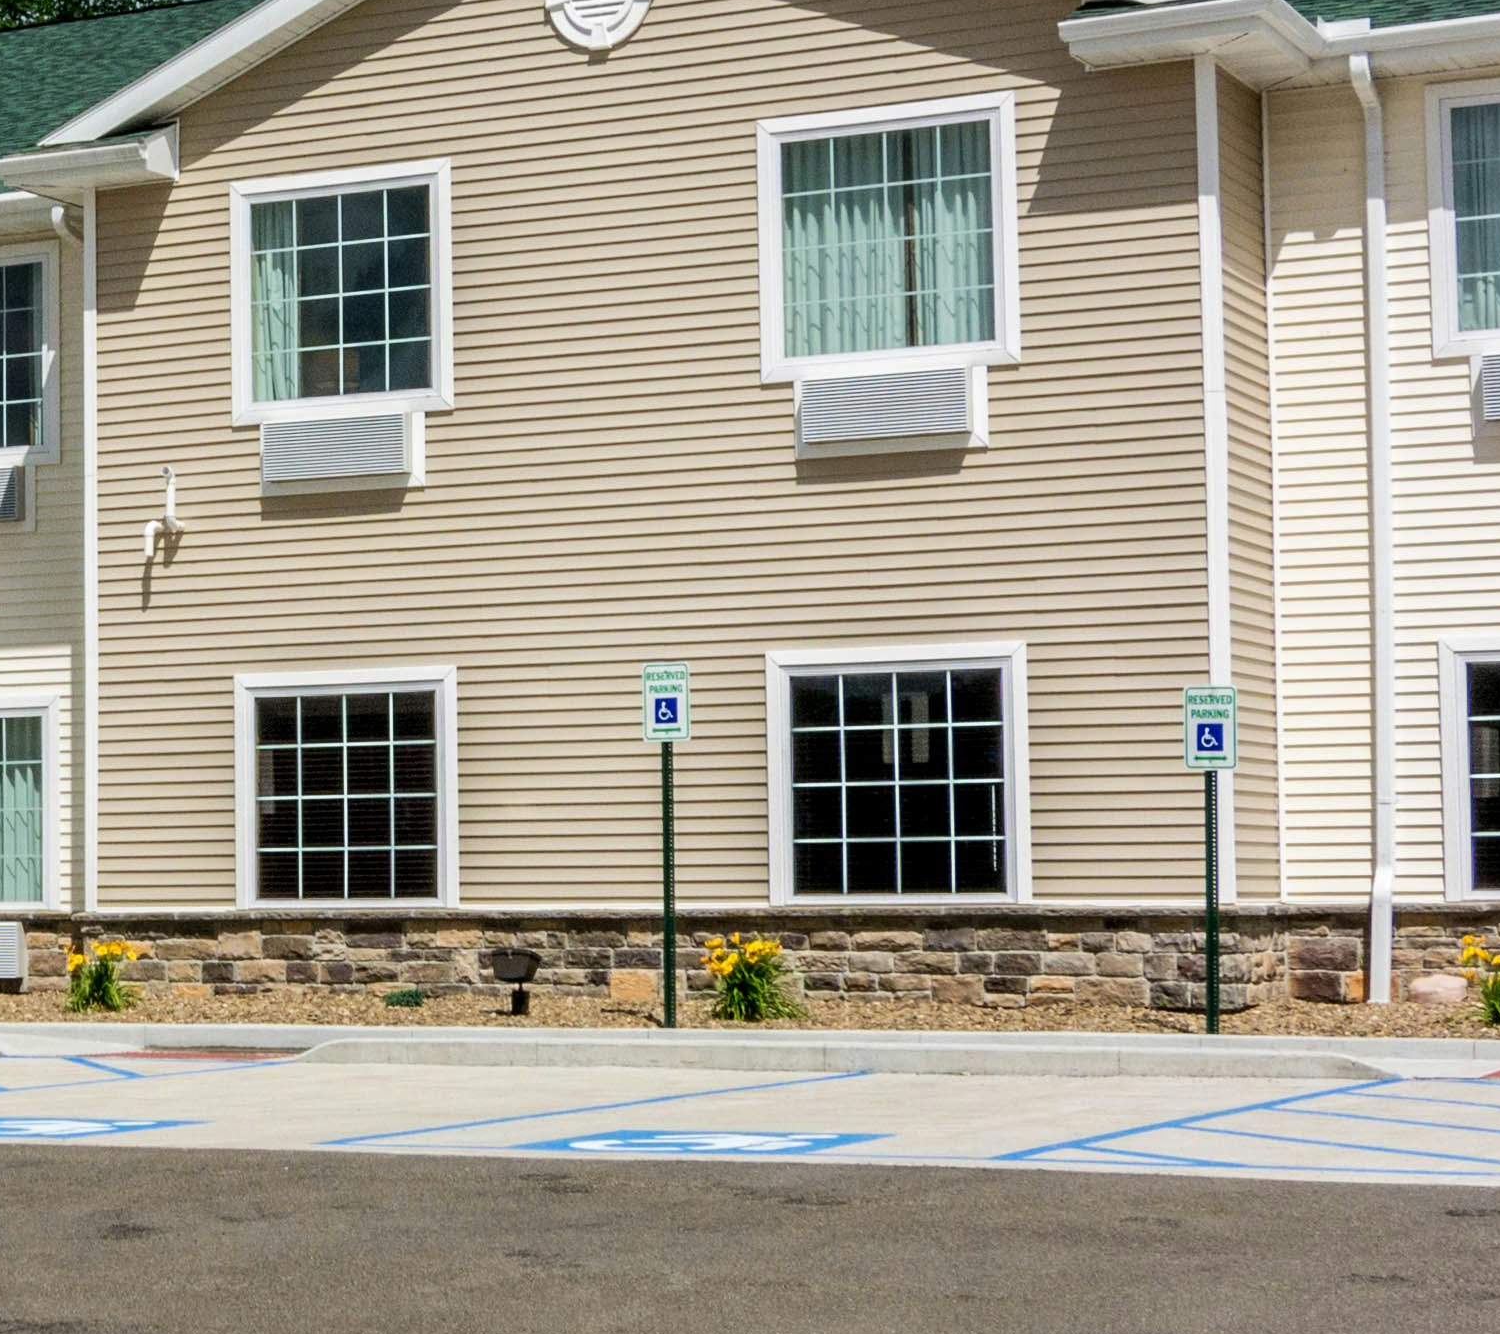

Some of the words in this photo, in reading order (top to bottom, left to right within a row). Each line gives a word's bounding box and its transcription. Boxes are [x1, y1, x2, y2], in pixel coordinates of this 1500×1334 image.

[645, 670, 686, 681] RESERVED
[649, 684, 683, 694] PARKING
[1188, 694, 1233, 706] RESERVED
[1191, 708, 1230, 719] PARKING
